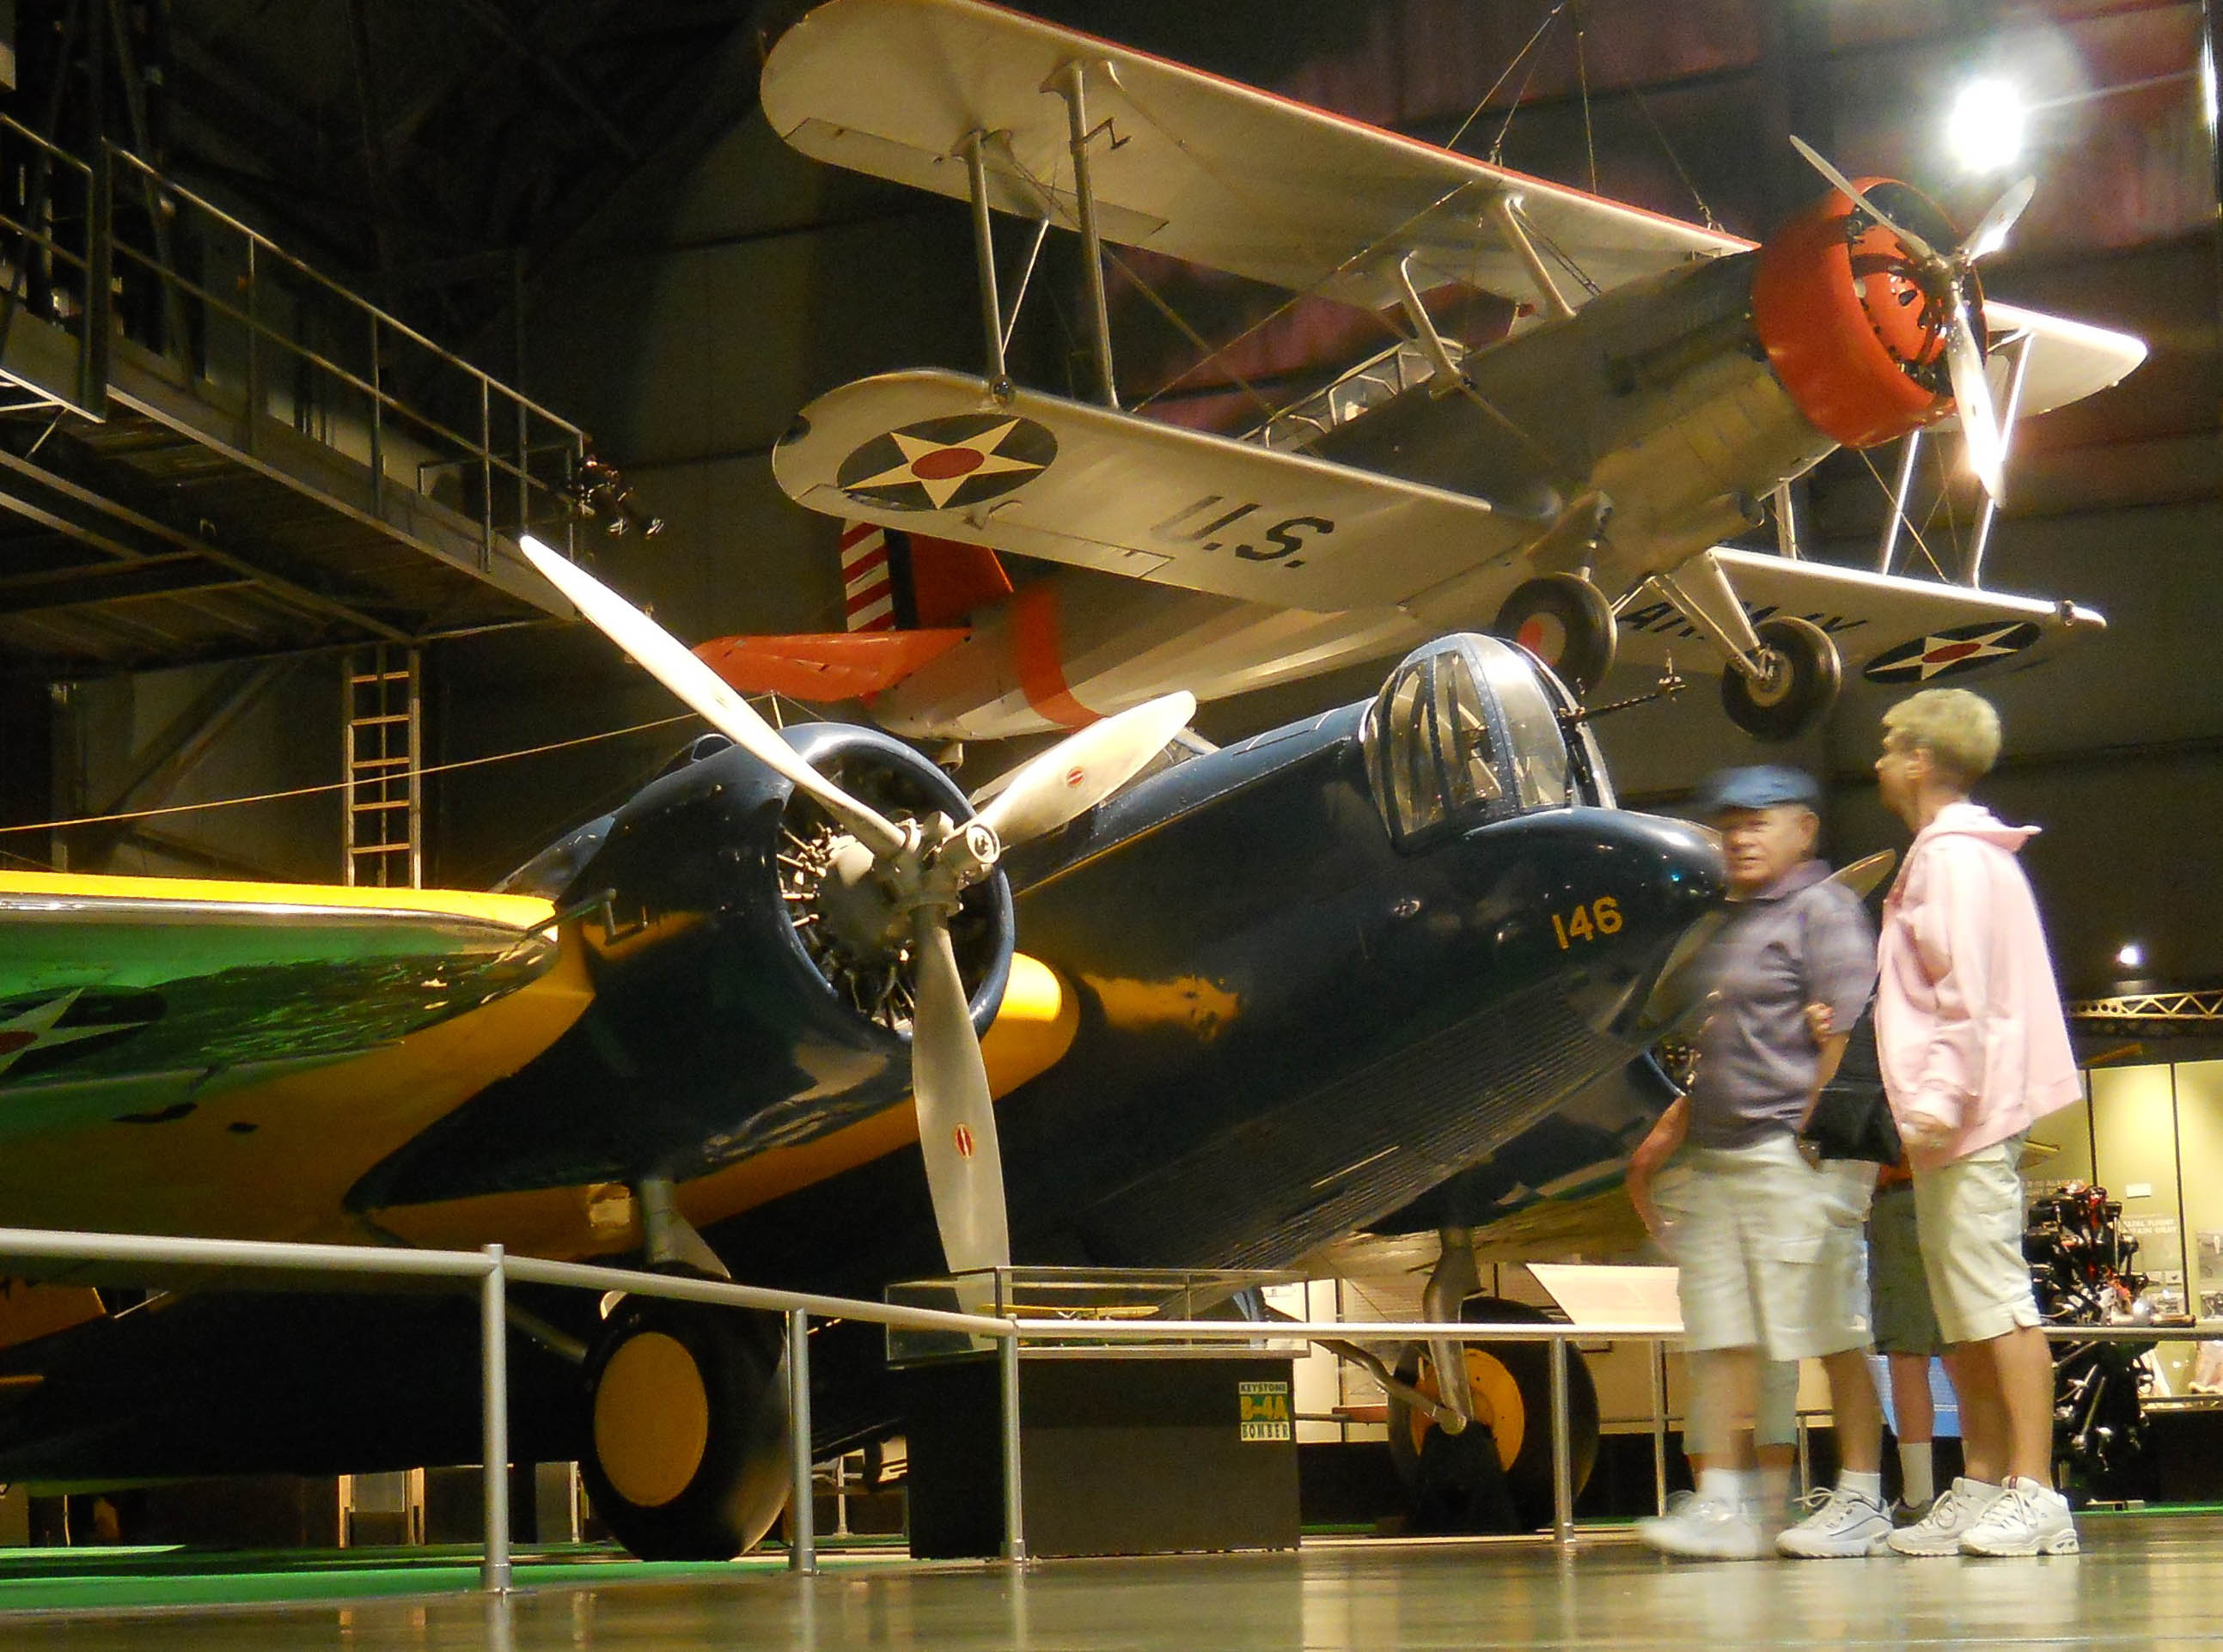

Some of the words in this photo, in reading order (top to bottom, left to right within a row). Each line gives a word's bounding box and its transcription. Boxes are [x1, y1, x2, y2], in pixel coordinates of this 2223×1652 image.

[1150, 495, 1335, 569] U.S.
[1551, 895, 1623, 950] 146
[1241, 1383, 1286, 1393] KEYSTONE
[1243, 1423, 1288, 1439] BOMBER
